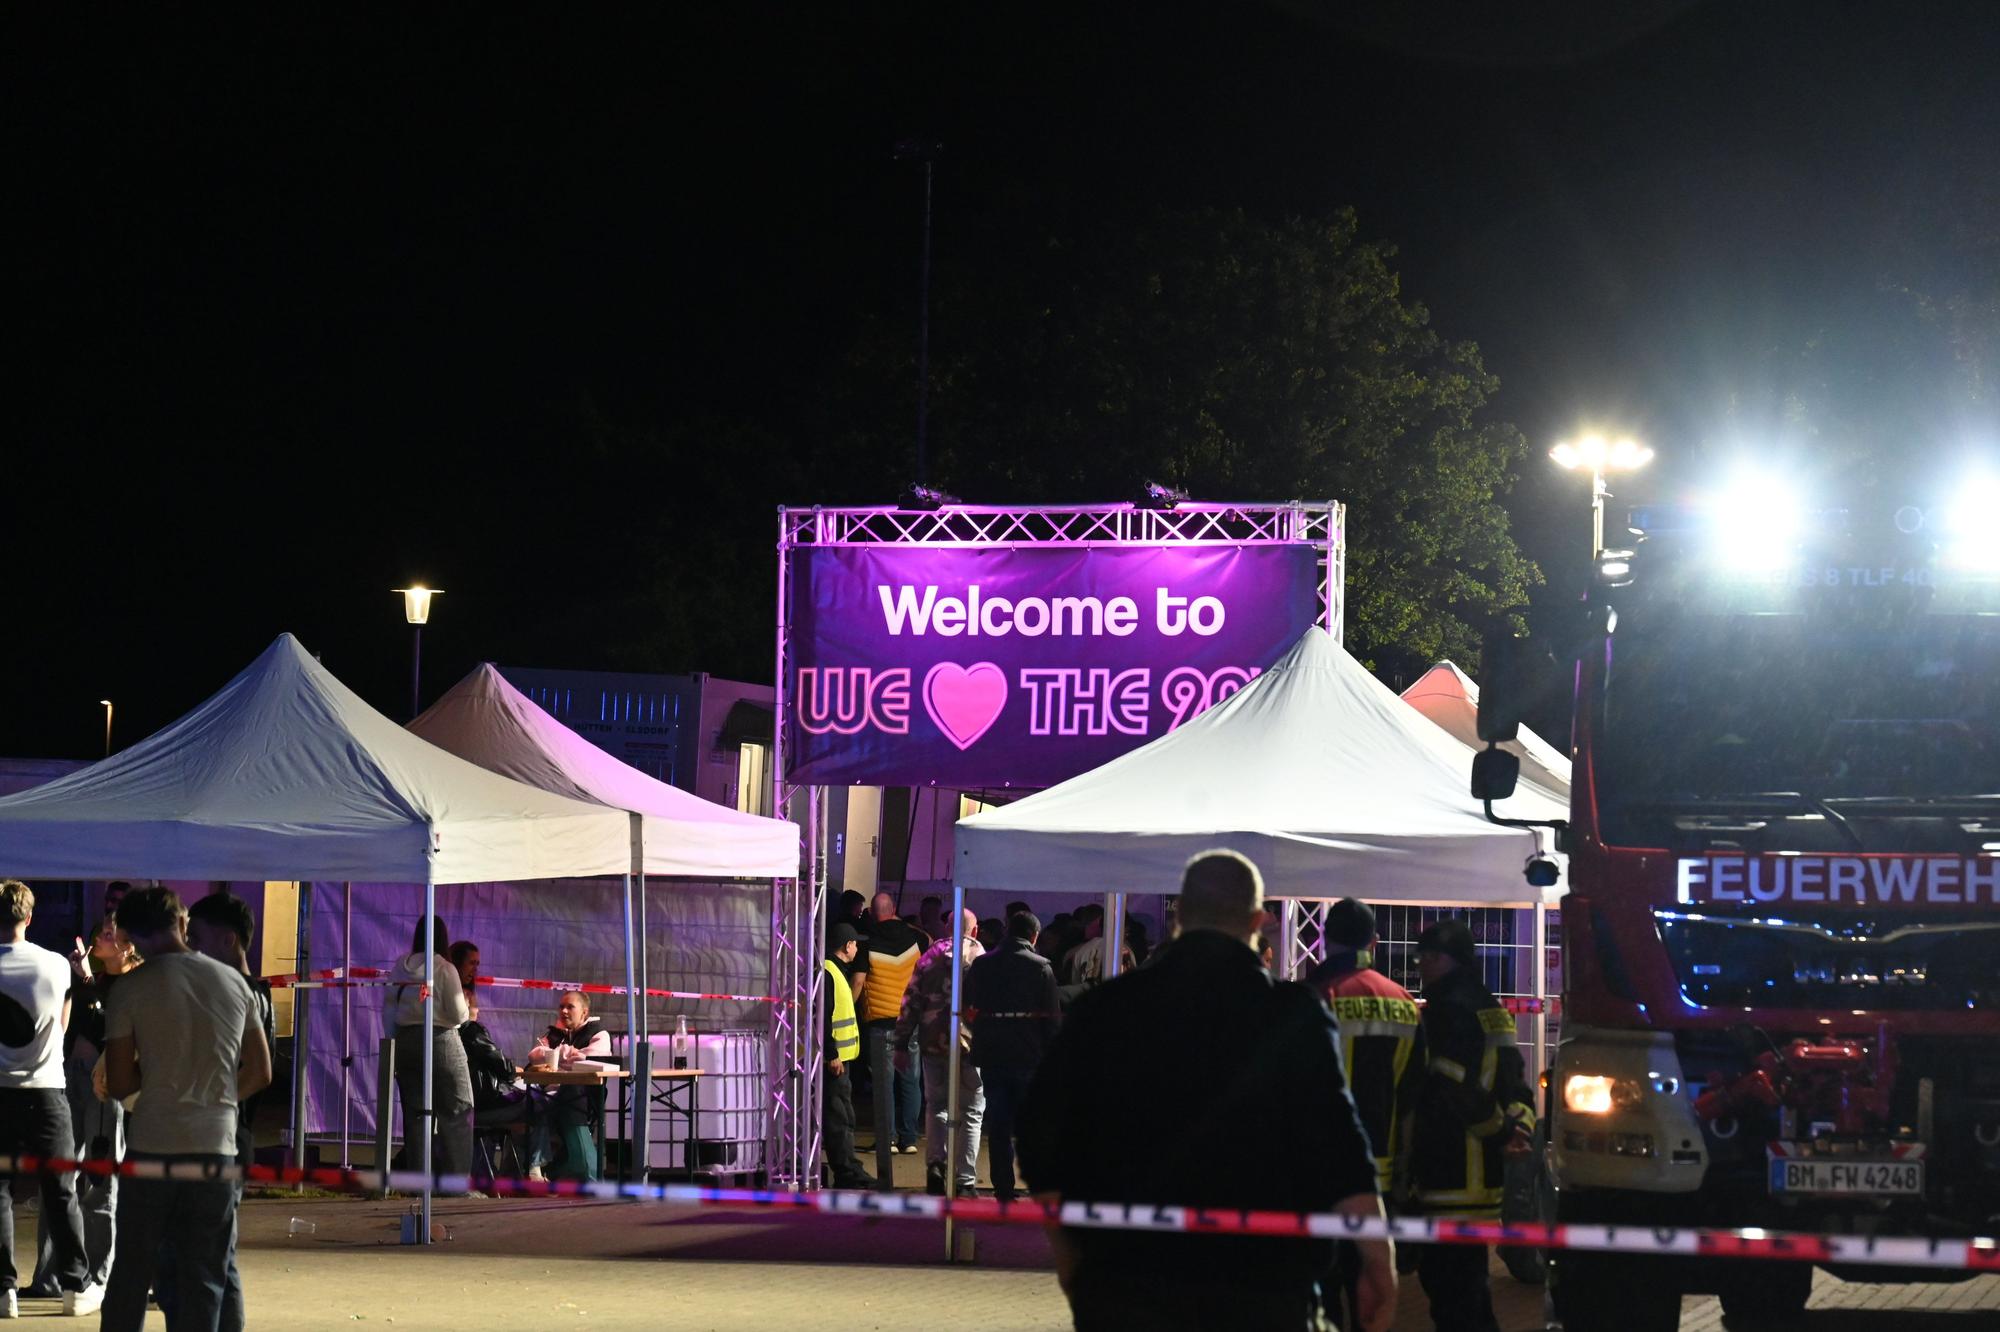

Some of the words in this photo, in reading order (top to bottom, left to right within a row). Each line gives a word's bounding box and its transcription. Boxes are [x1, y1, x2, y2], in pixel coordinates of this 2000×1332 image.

[1847, 568, 1896, 586] TLF
[878, 584, 1138, 637] Welcome
[1156, 587, 1226, 637] to
[798, 667, 911, 735] WE
[1020, 667, 1150, 735] THE
[1787, 1164, 1815, 1187] BM
[1831, 1166, 1858, 1187] FW
[1864, 1166, 1917, 1190] 4248
